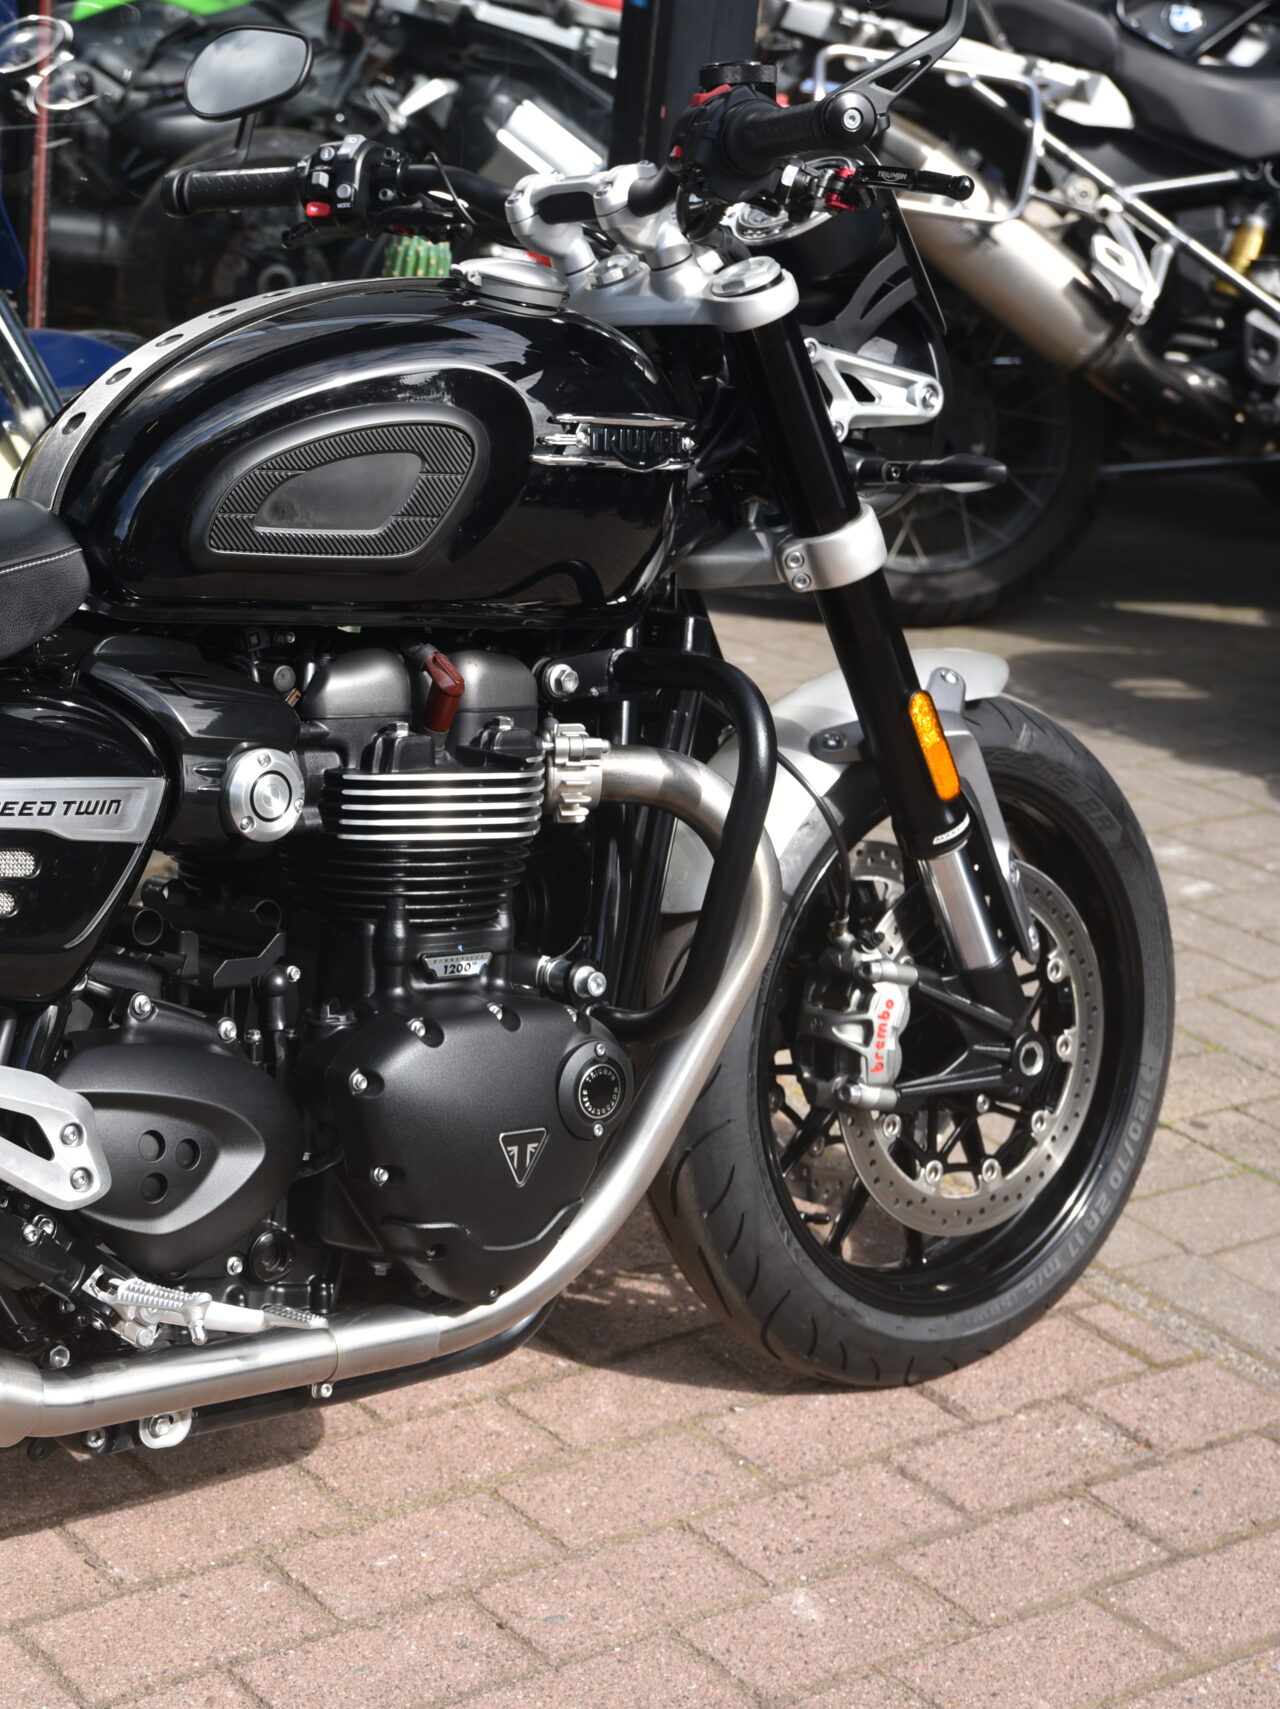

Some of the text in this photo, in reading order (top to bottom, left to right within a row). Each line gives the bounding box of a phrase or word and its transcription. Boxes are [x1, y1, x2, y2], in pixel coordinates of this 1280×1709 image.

[877, 170, 907, 182] TRIUMPH
[587, 427, 682, 452] TRIUMPH
[62, 799, 123, 816] TWIN
[443, 962, 472, 975] 1200
[869, 998, 895, 1075] brembo
[1109, 1092, 1152, 1191] 120/70
